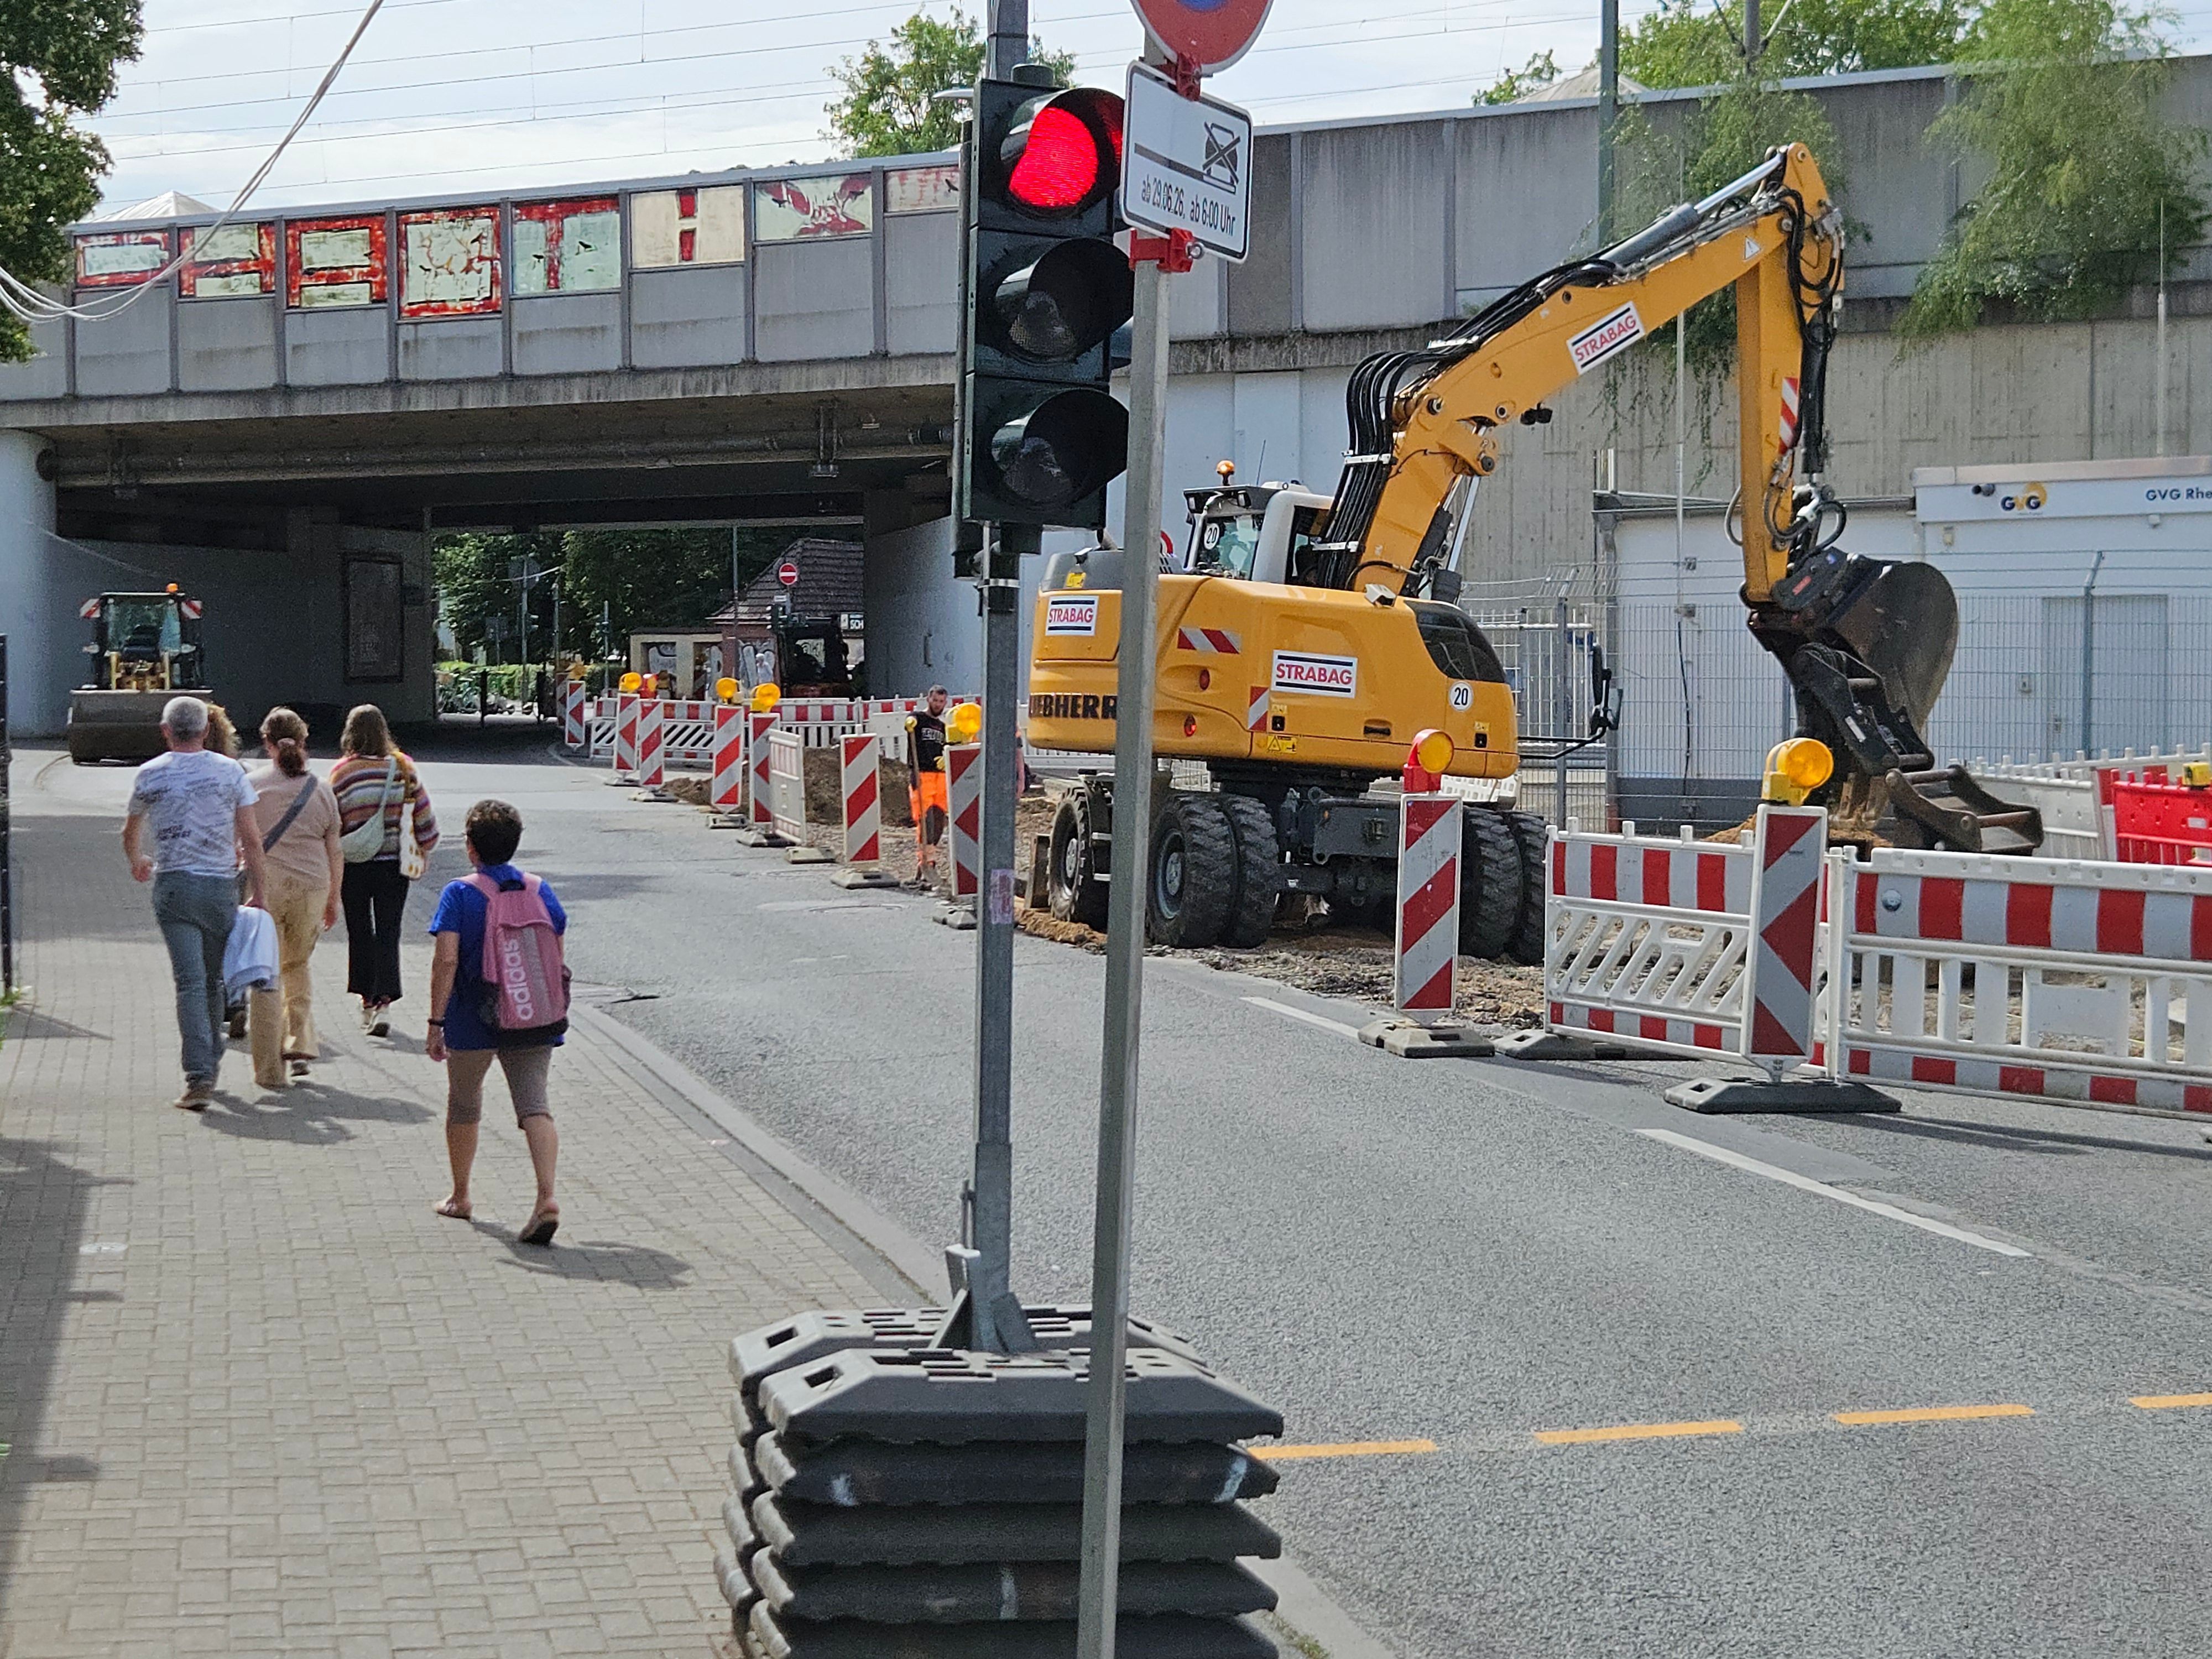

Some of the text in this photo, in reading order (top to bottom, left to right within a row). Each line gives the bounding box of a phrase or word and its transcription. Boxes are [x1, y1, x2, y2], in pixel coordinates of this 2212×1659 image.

[1141, 174, 1151, 204] ab
[1190, 195, 1200, 222] ab
[1220, 204, 1236, 237] Uhr
[1574, 315, 1636, 362] STRABAG
[2001, 495, 2041, 511] GVG
[2146, 488, 2180, 501] GVG
[1207, 527, 1218, 544] 20
[1048, 608, 1093, 623] STRABAG
[1276, 663, 1353, 685] STRABAG
[1454, 687, 1469, 706] 20
[504, 938, 534, 1021] adidas
